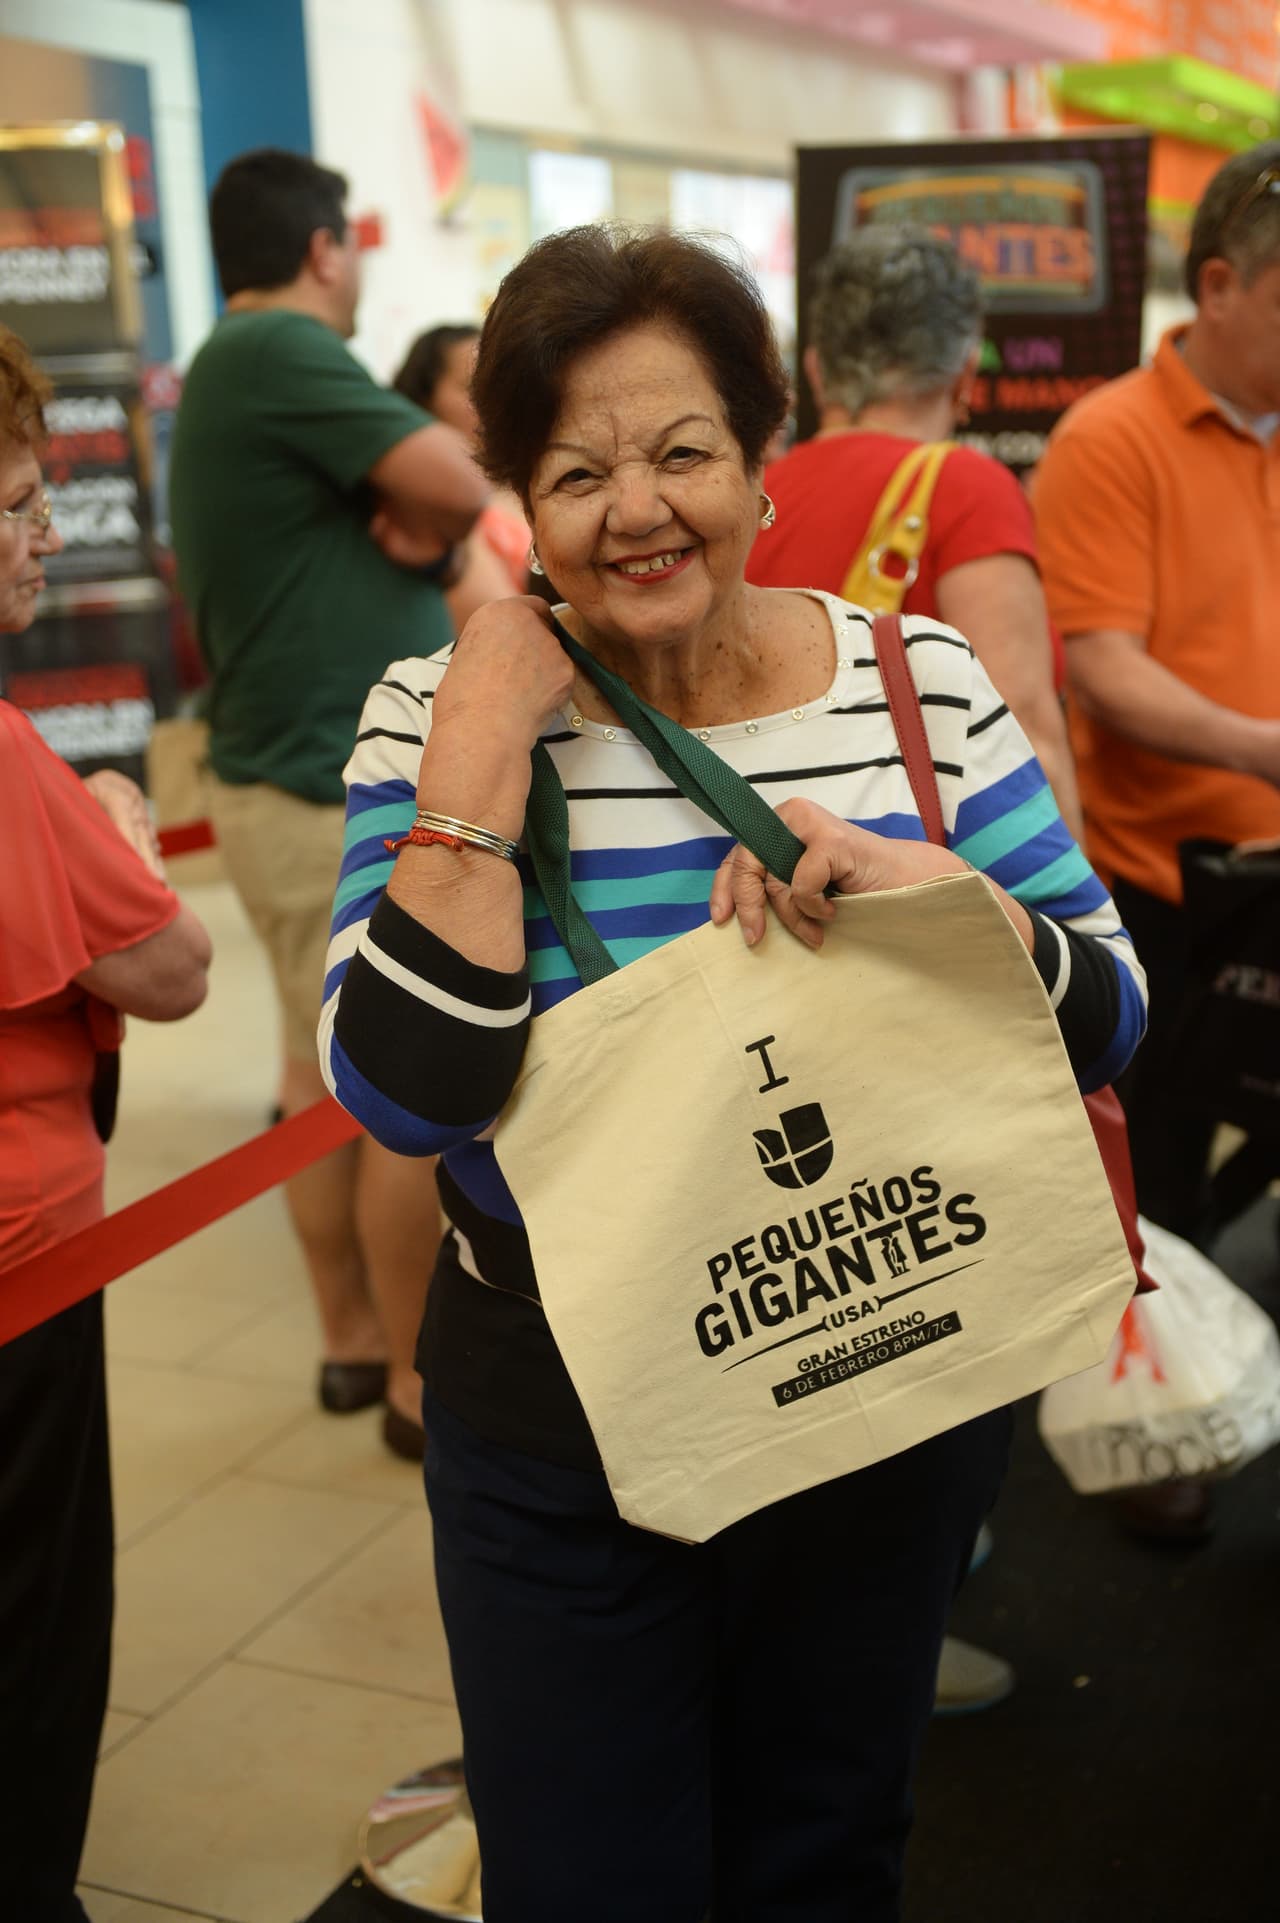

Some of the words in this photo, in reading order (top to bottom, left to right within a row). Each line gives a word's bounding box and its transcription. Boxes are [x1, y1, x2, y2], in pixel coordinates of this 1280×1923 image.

[745, 1035, 789, 1094] I
[706, 1165, 942, 1294] PEQUEÑOS
[694, 1193, 987, 1358] GIGANTES
[783, 1387, 793, 1399] 6
[795, 1376, 816, 1394] DE
[820, 1346, 889, 1384] FEBRERO
[893, 1318, 953, 1353] 8PM/7C
[797, 1342, 848, 1373] GRAN
[851, 1310, 926, 1351] ESTRENO
